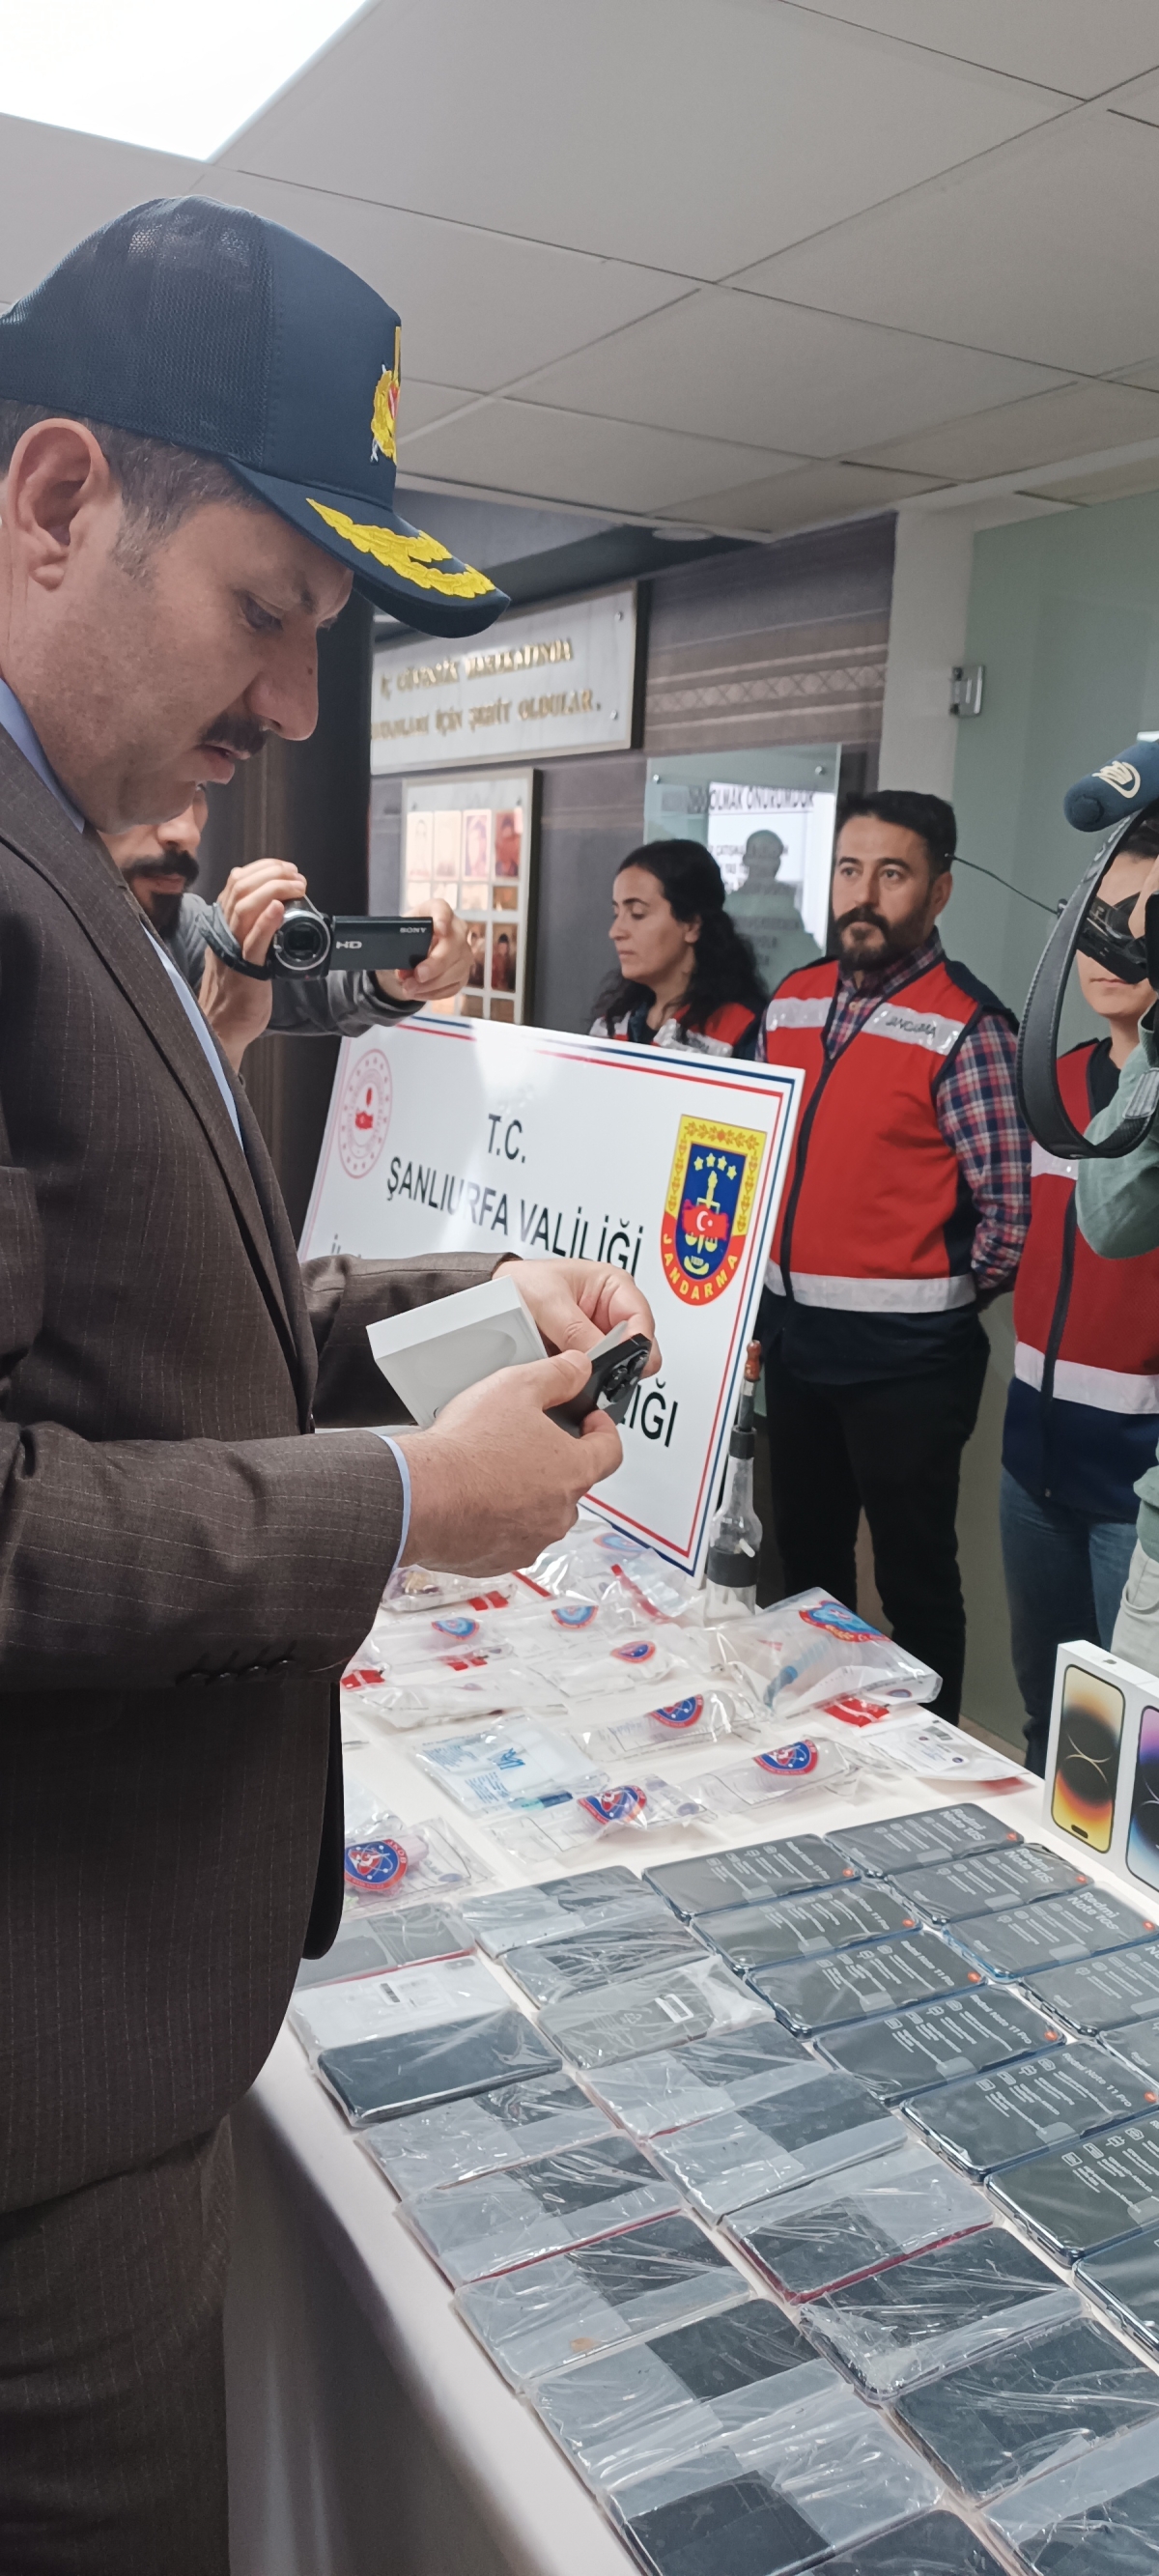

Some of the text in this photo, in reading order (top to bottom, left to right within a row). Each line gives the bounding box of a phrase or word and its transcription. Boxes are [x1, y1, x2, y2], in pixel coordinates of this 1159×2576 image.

[335, 940, 362, 949] HD
[488, 1113, 526, 1164] T.C.
[386, 1155, 644, 1277] ŞANLIURFA VALİLİĞİ
[663, 1233, 738, 1300] JANDARMA
[939, 1810, 966, 1829] Note
[950, 1807, 987, 1830] Redmi
[1004, 1851, 1032, 1870] Note
[1016, 1847, 1055, 1872] Redmi
[1066, 1896, 1097, 1915] Note
[1079, 1891, 1120, 1918] Redmi
[1008, 2024, 1021, 2033] 11
[1017, 2031, 1032, 2045] Pro
[1085, 2069, 1107, 2084] Note
[1106, 2084, 1119, 2095] 11
[1116, 2093, 1132, 2108] Pro
